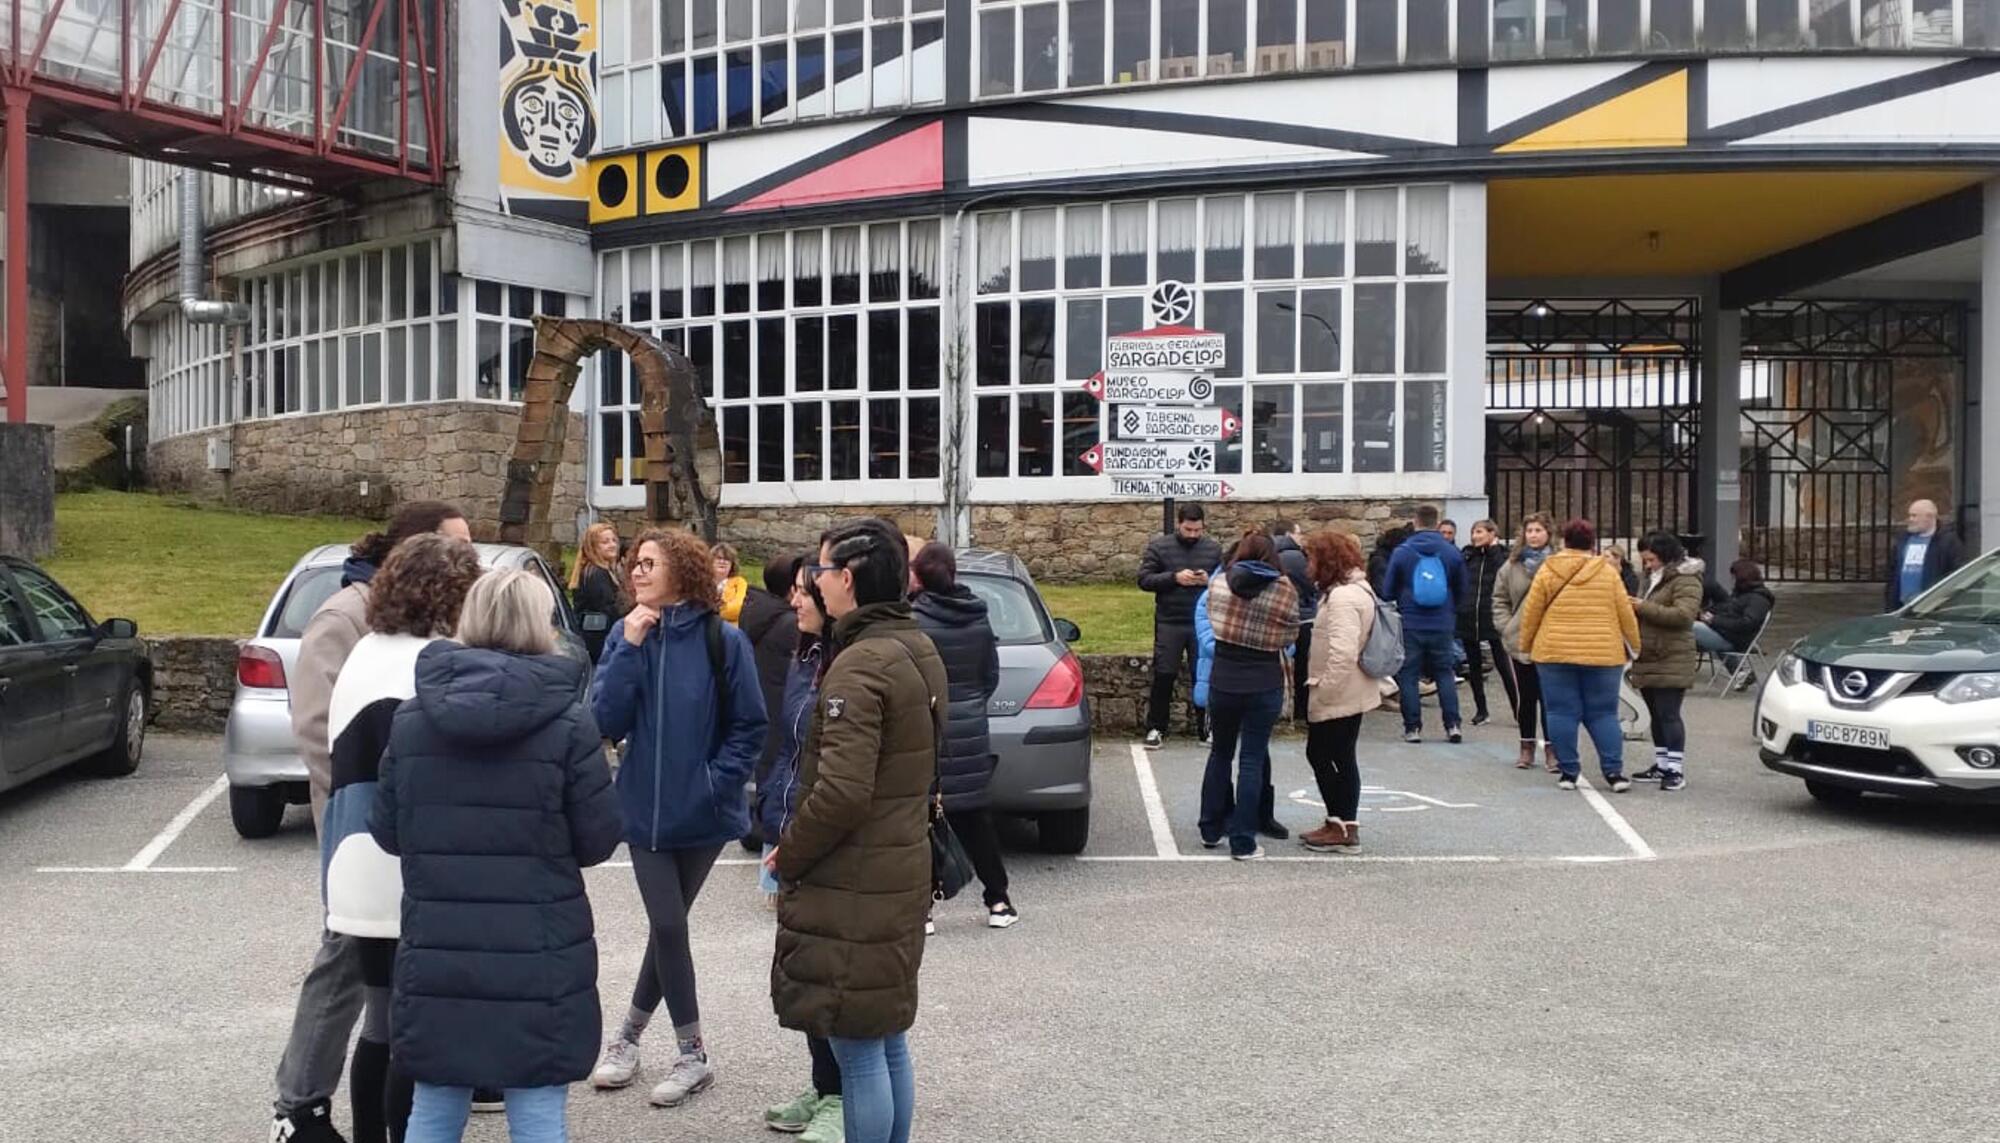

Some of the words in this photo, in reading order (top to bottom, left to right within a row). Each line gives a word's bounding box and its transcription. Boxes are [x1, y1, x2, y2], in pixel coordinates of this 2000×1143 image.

[1110, 349, 1223, 367] SARGADELOS
[1106, 376, 1148, 387] MUSEO
[1106, 387, 1185, 399] SARGADELOS
[1145, 411, 1195, 423] TABERNA
[1145, 423, 1219, 436] SARGADELOS
[1104, 445, 1167, 457] FUNDACIÓN
[1104, 457, 1186, 469] SARGADELOS
